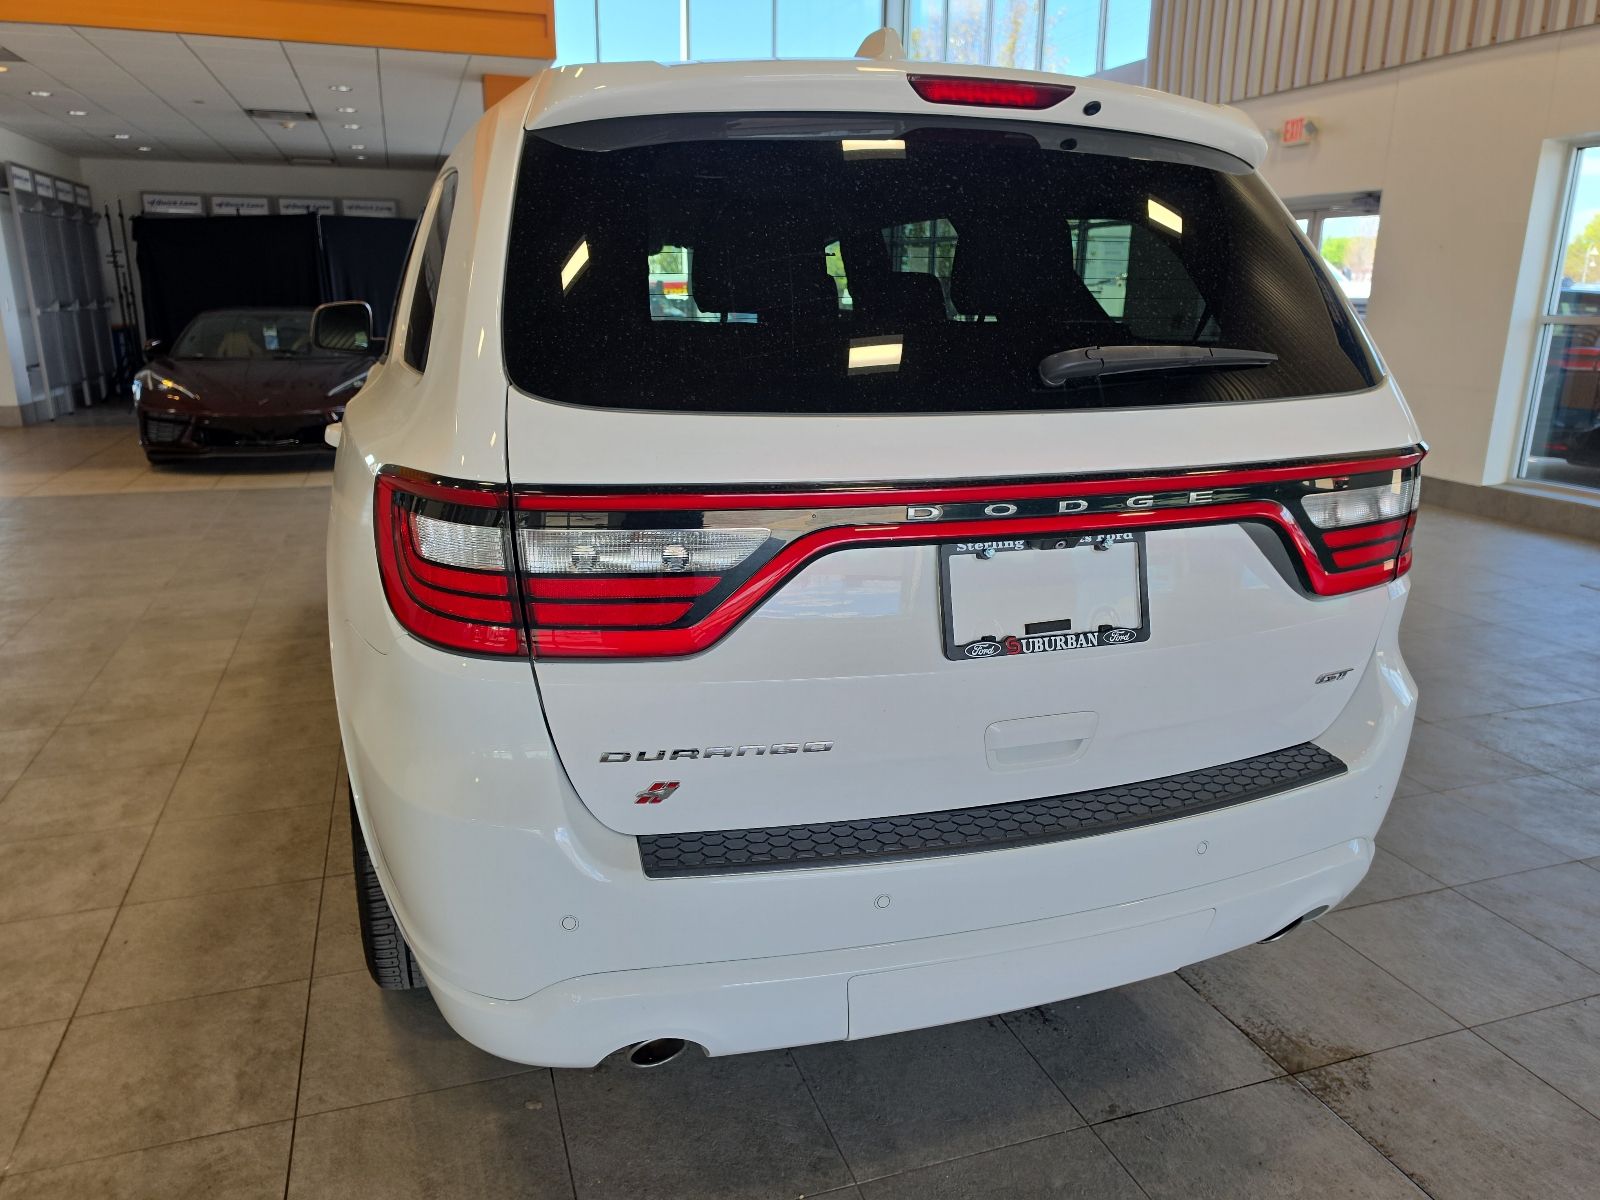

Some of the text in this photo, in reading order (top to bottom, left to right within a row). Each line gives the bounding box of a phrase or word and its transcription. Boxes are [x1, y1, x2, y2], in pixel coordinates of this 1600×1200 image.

[1283, 118, 1305, 142] EXIT
[906, 490, 1213, 520] DODGE
[956, 539, 1025, 551] Sterling
[1006, 633, 1099, 655] SUBURBAN
[1109, 630, 1131, 642] Ford
[971, 643, 995, 656] Ford
[1314, 668, 1354, 684] GT
[600, 741, 834, 762] DURANGO
